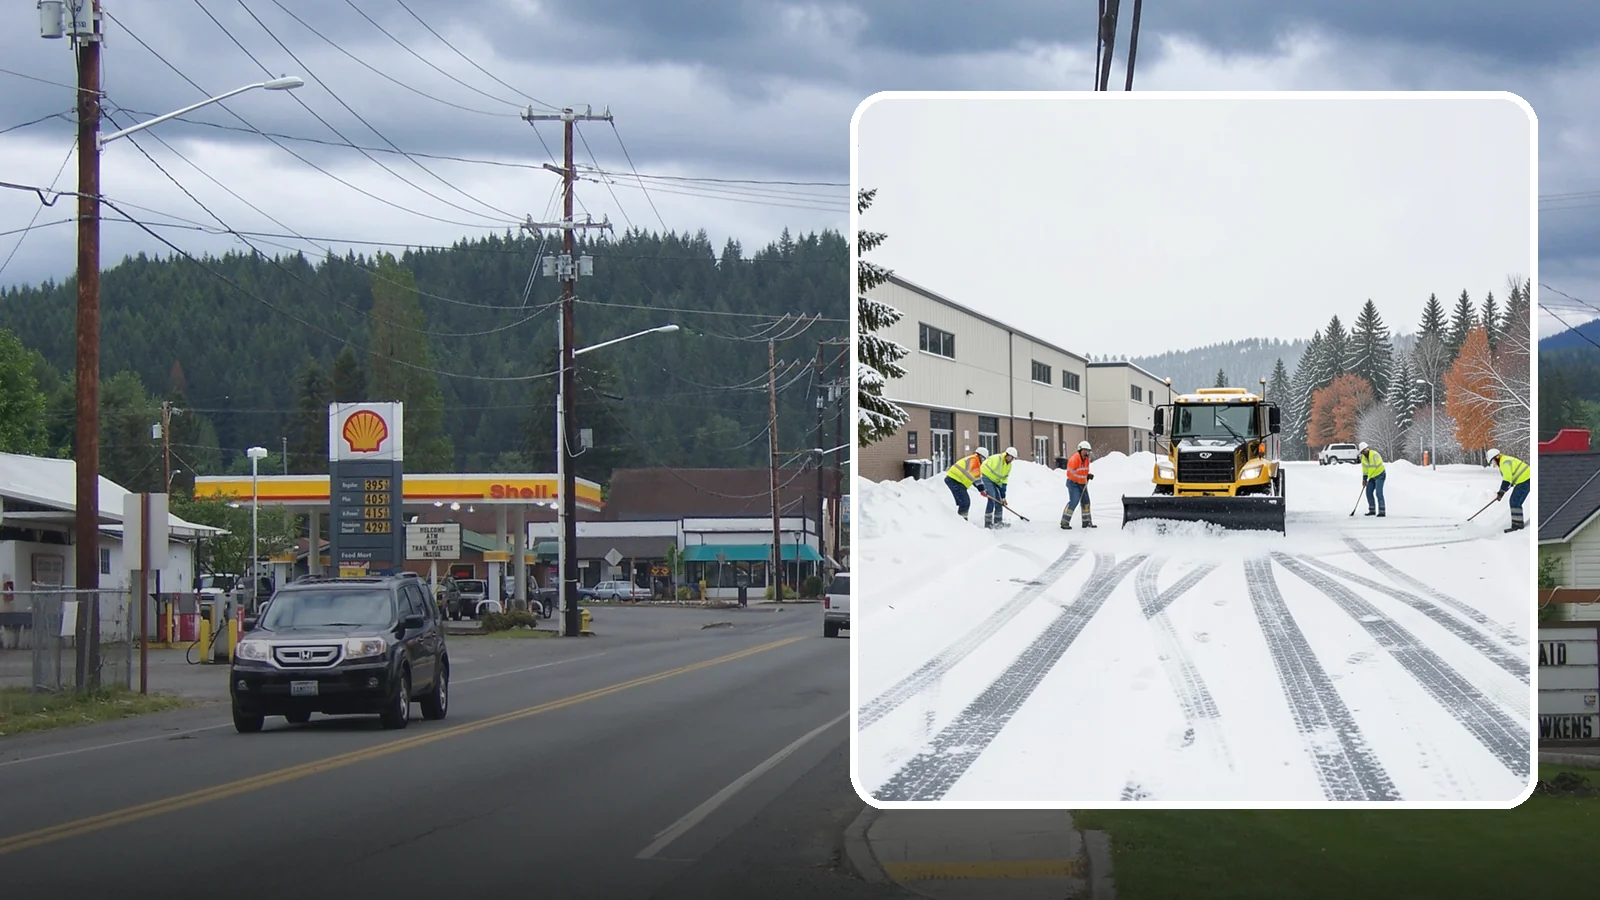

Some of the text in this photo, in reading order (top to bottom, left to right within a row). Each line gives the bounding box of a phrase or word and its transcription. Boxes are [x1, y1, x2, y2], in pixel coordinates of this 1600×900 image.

[366, 480, 383, 490] 395
[490, 484, 547, 499] Shell
[366, 494, 383, 504] 405
[366, 508, 383, 518] 415
[366, 522, 383, 532] 429
